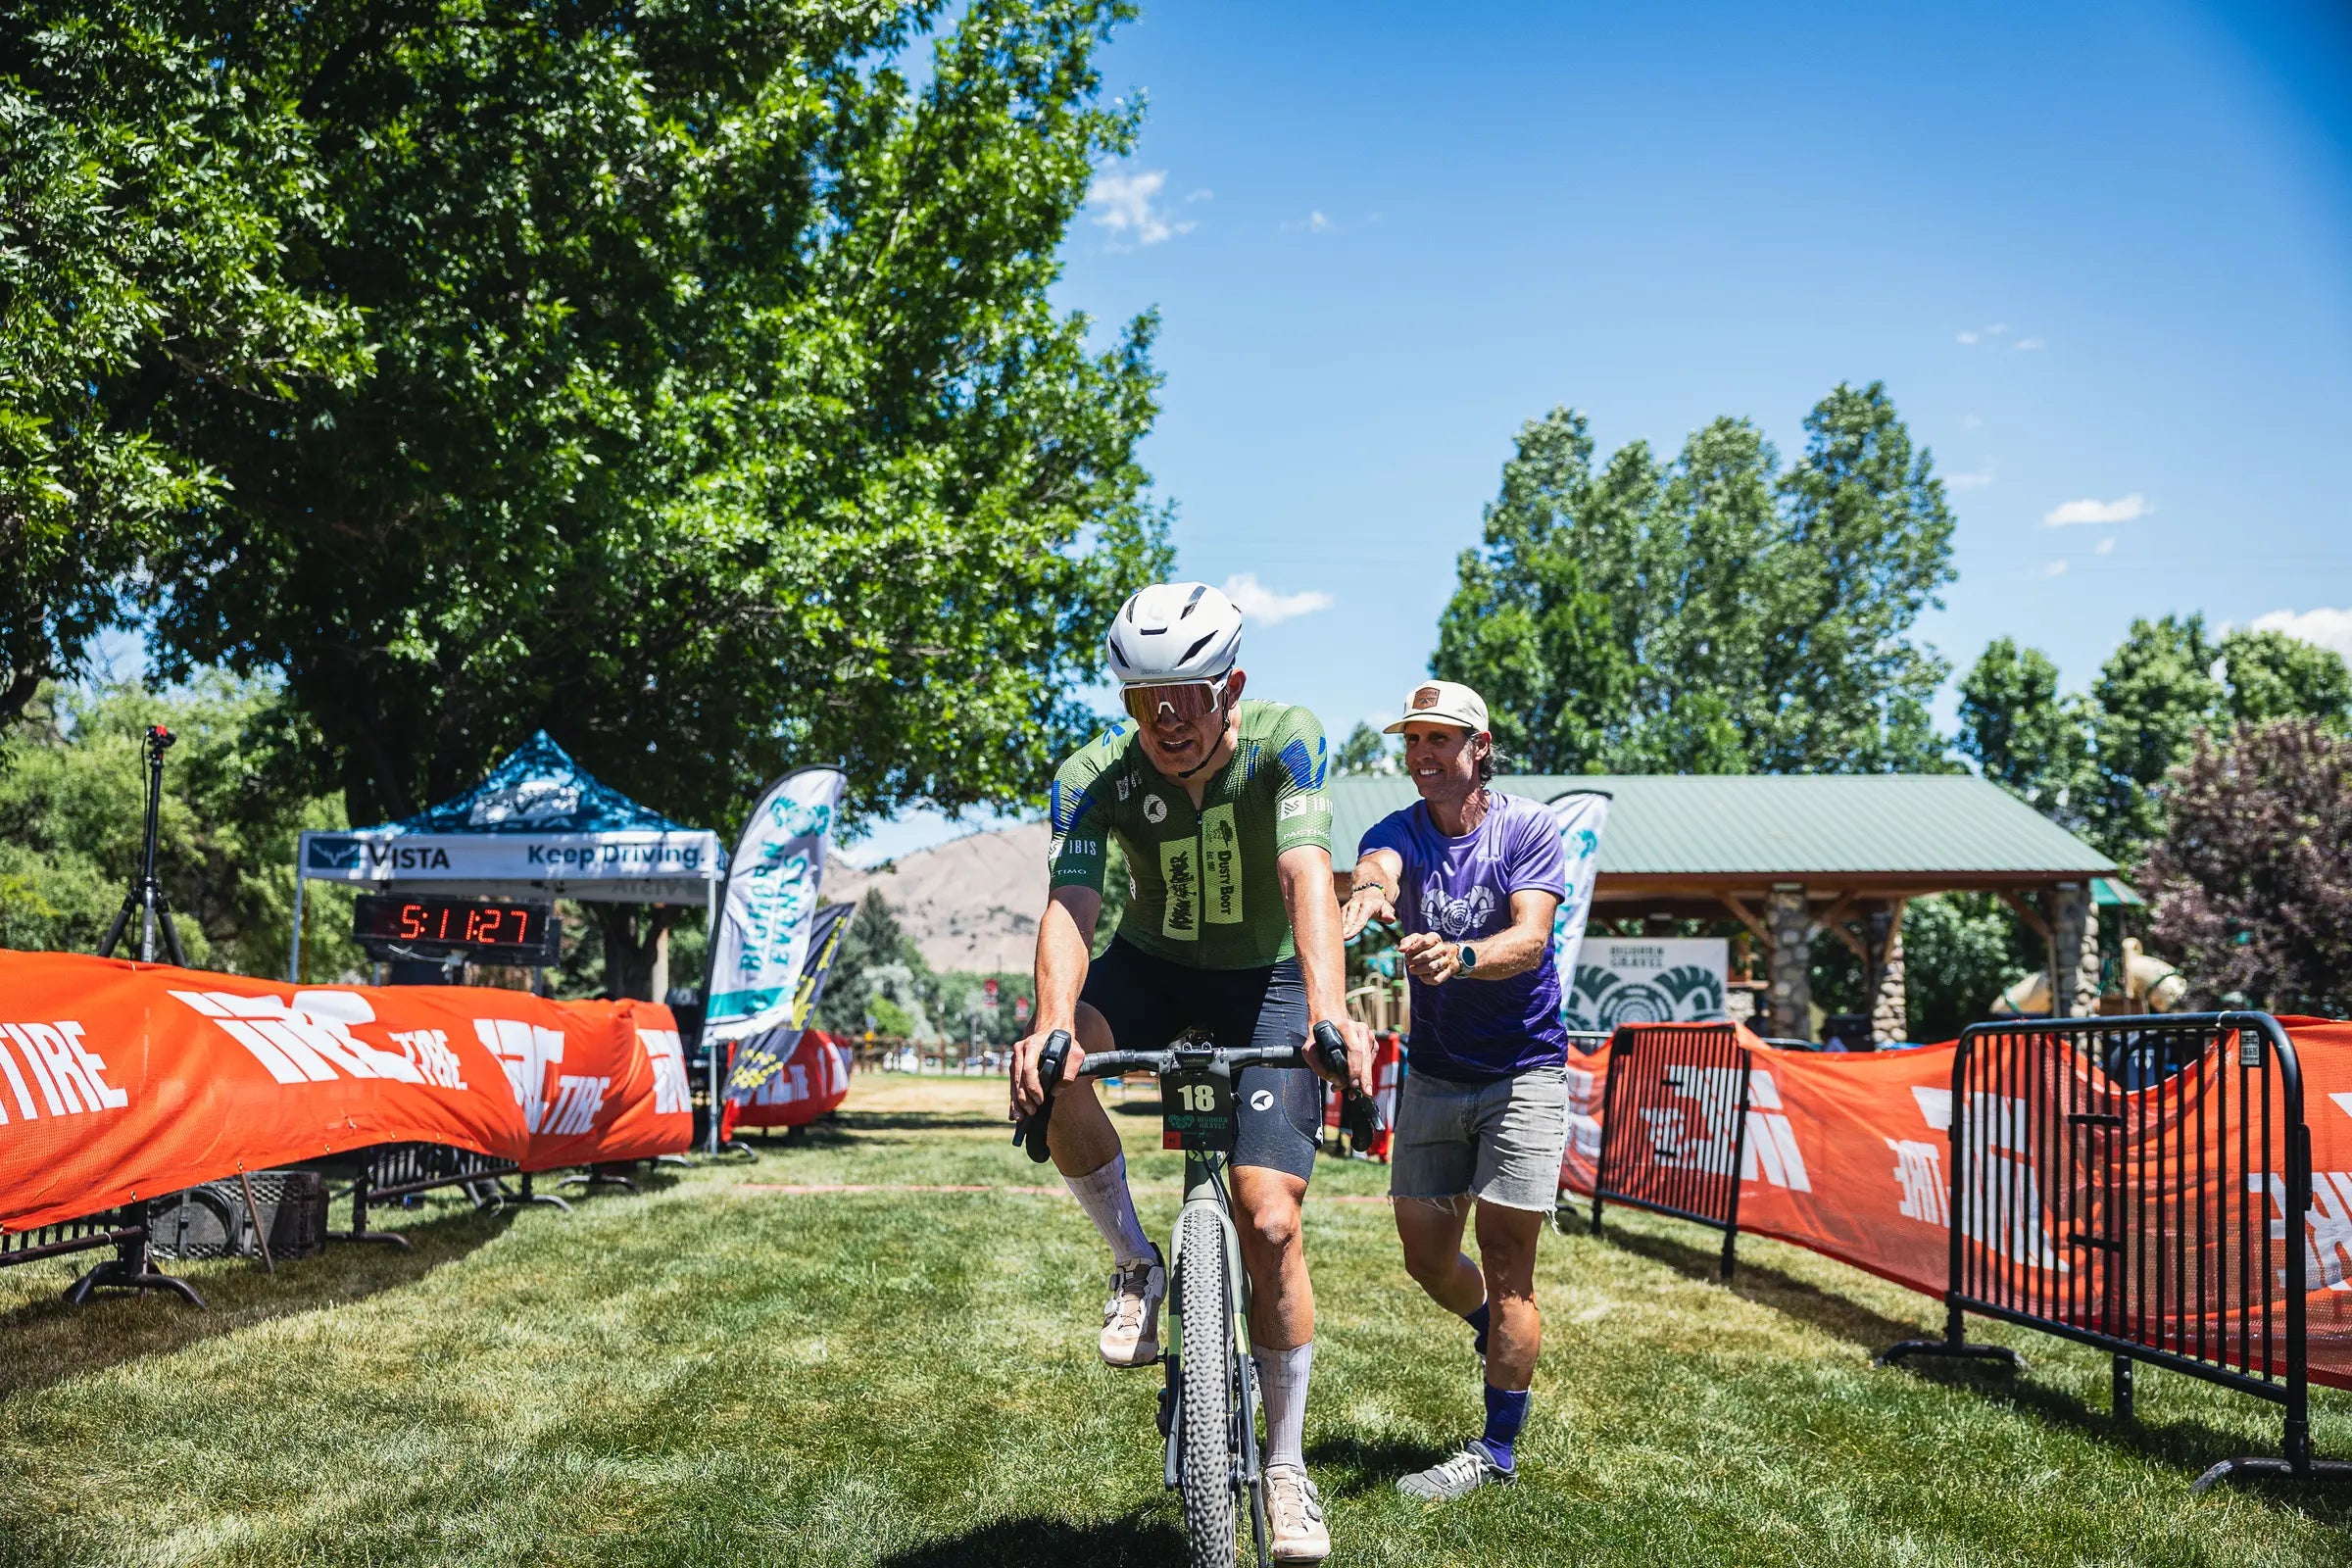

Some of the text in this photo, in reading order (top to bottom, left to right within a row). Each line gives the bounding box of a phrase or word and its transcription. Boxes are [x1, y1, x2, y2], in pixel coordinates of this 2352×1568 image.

[368, 843, 451, 871] VISTA
[527, 844, 706, 870] Keep Driving.
[1051, 868, 1087, 878] CTIMO
[1068, 839, 1097, 857] IBIS
[739, 841, 785, 971] BIGHORN
[1216, 849, 1235, 915] DUSTY BOOT
[400, 904, 528, 945] 5:11:27
[770, 856, 808, 965] EVENTS
[0, 1020, 128, 1125] TIRE
[388, 1029, 468, 1091] TIRE
[542, 1074, 611, 1135] TIRE
[1177, 1084, 1215, 1112] 18
